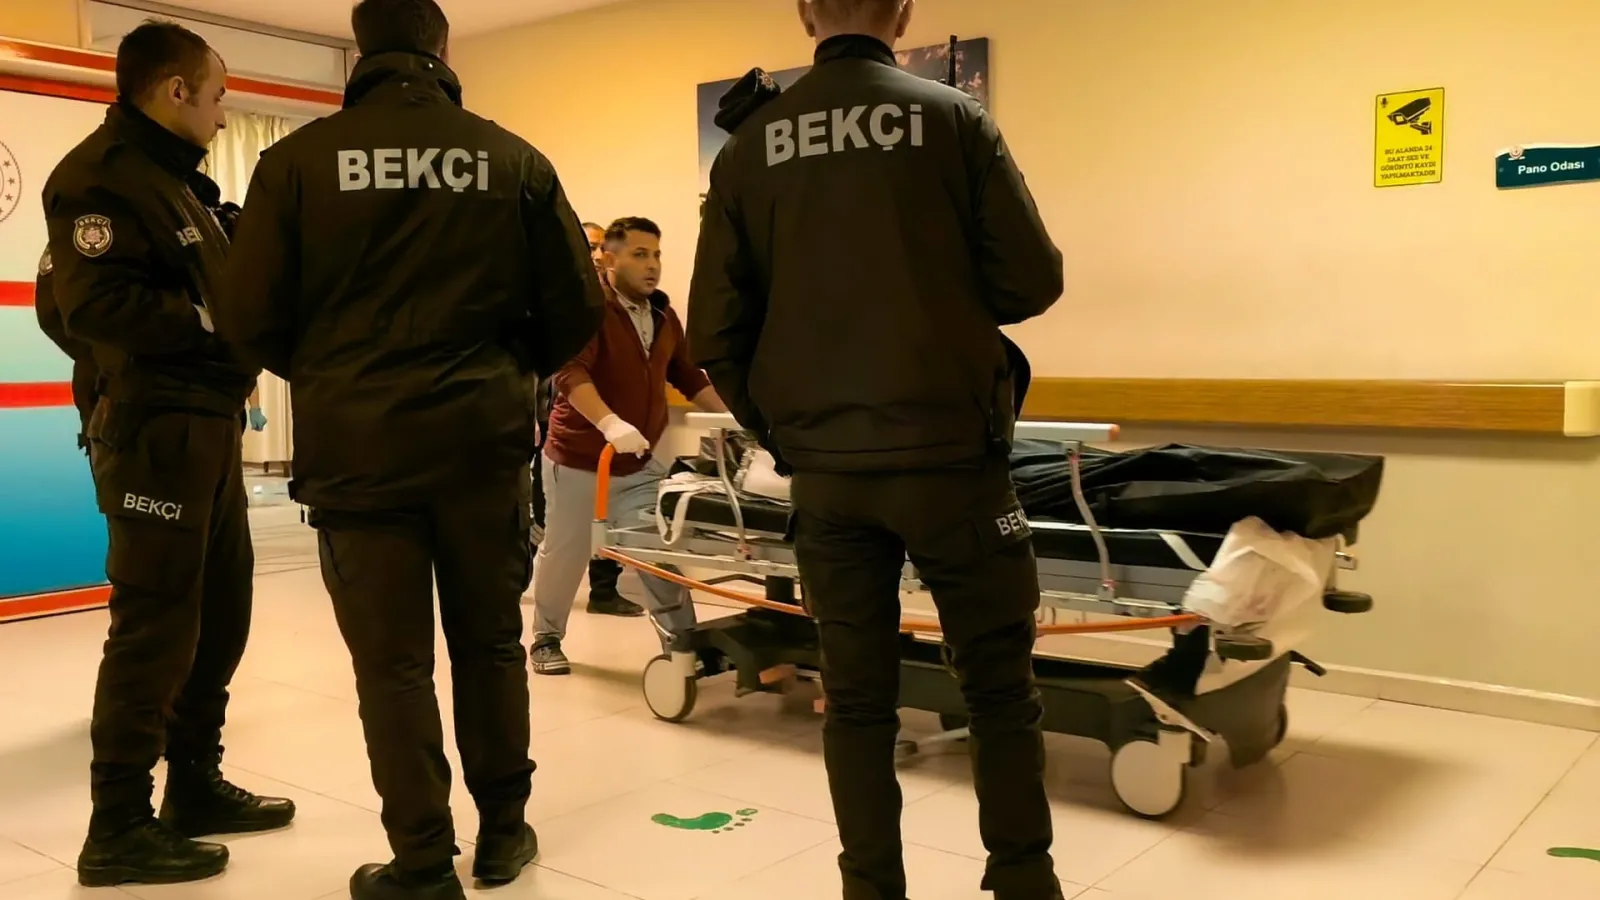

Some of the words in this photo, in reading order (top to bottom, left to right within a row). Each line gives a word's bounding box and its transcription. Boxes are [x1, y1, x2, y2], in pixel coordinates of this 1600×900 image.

[1395, 146, 1424, 154] ALANDA
[1518, 165, 1547, 175] Pano
[1550, 161, 1585, 171] Odası
[995, 508, 1030, 536] BEK
